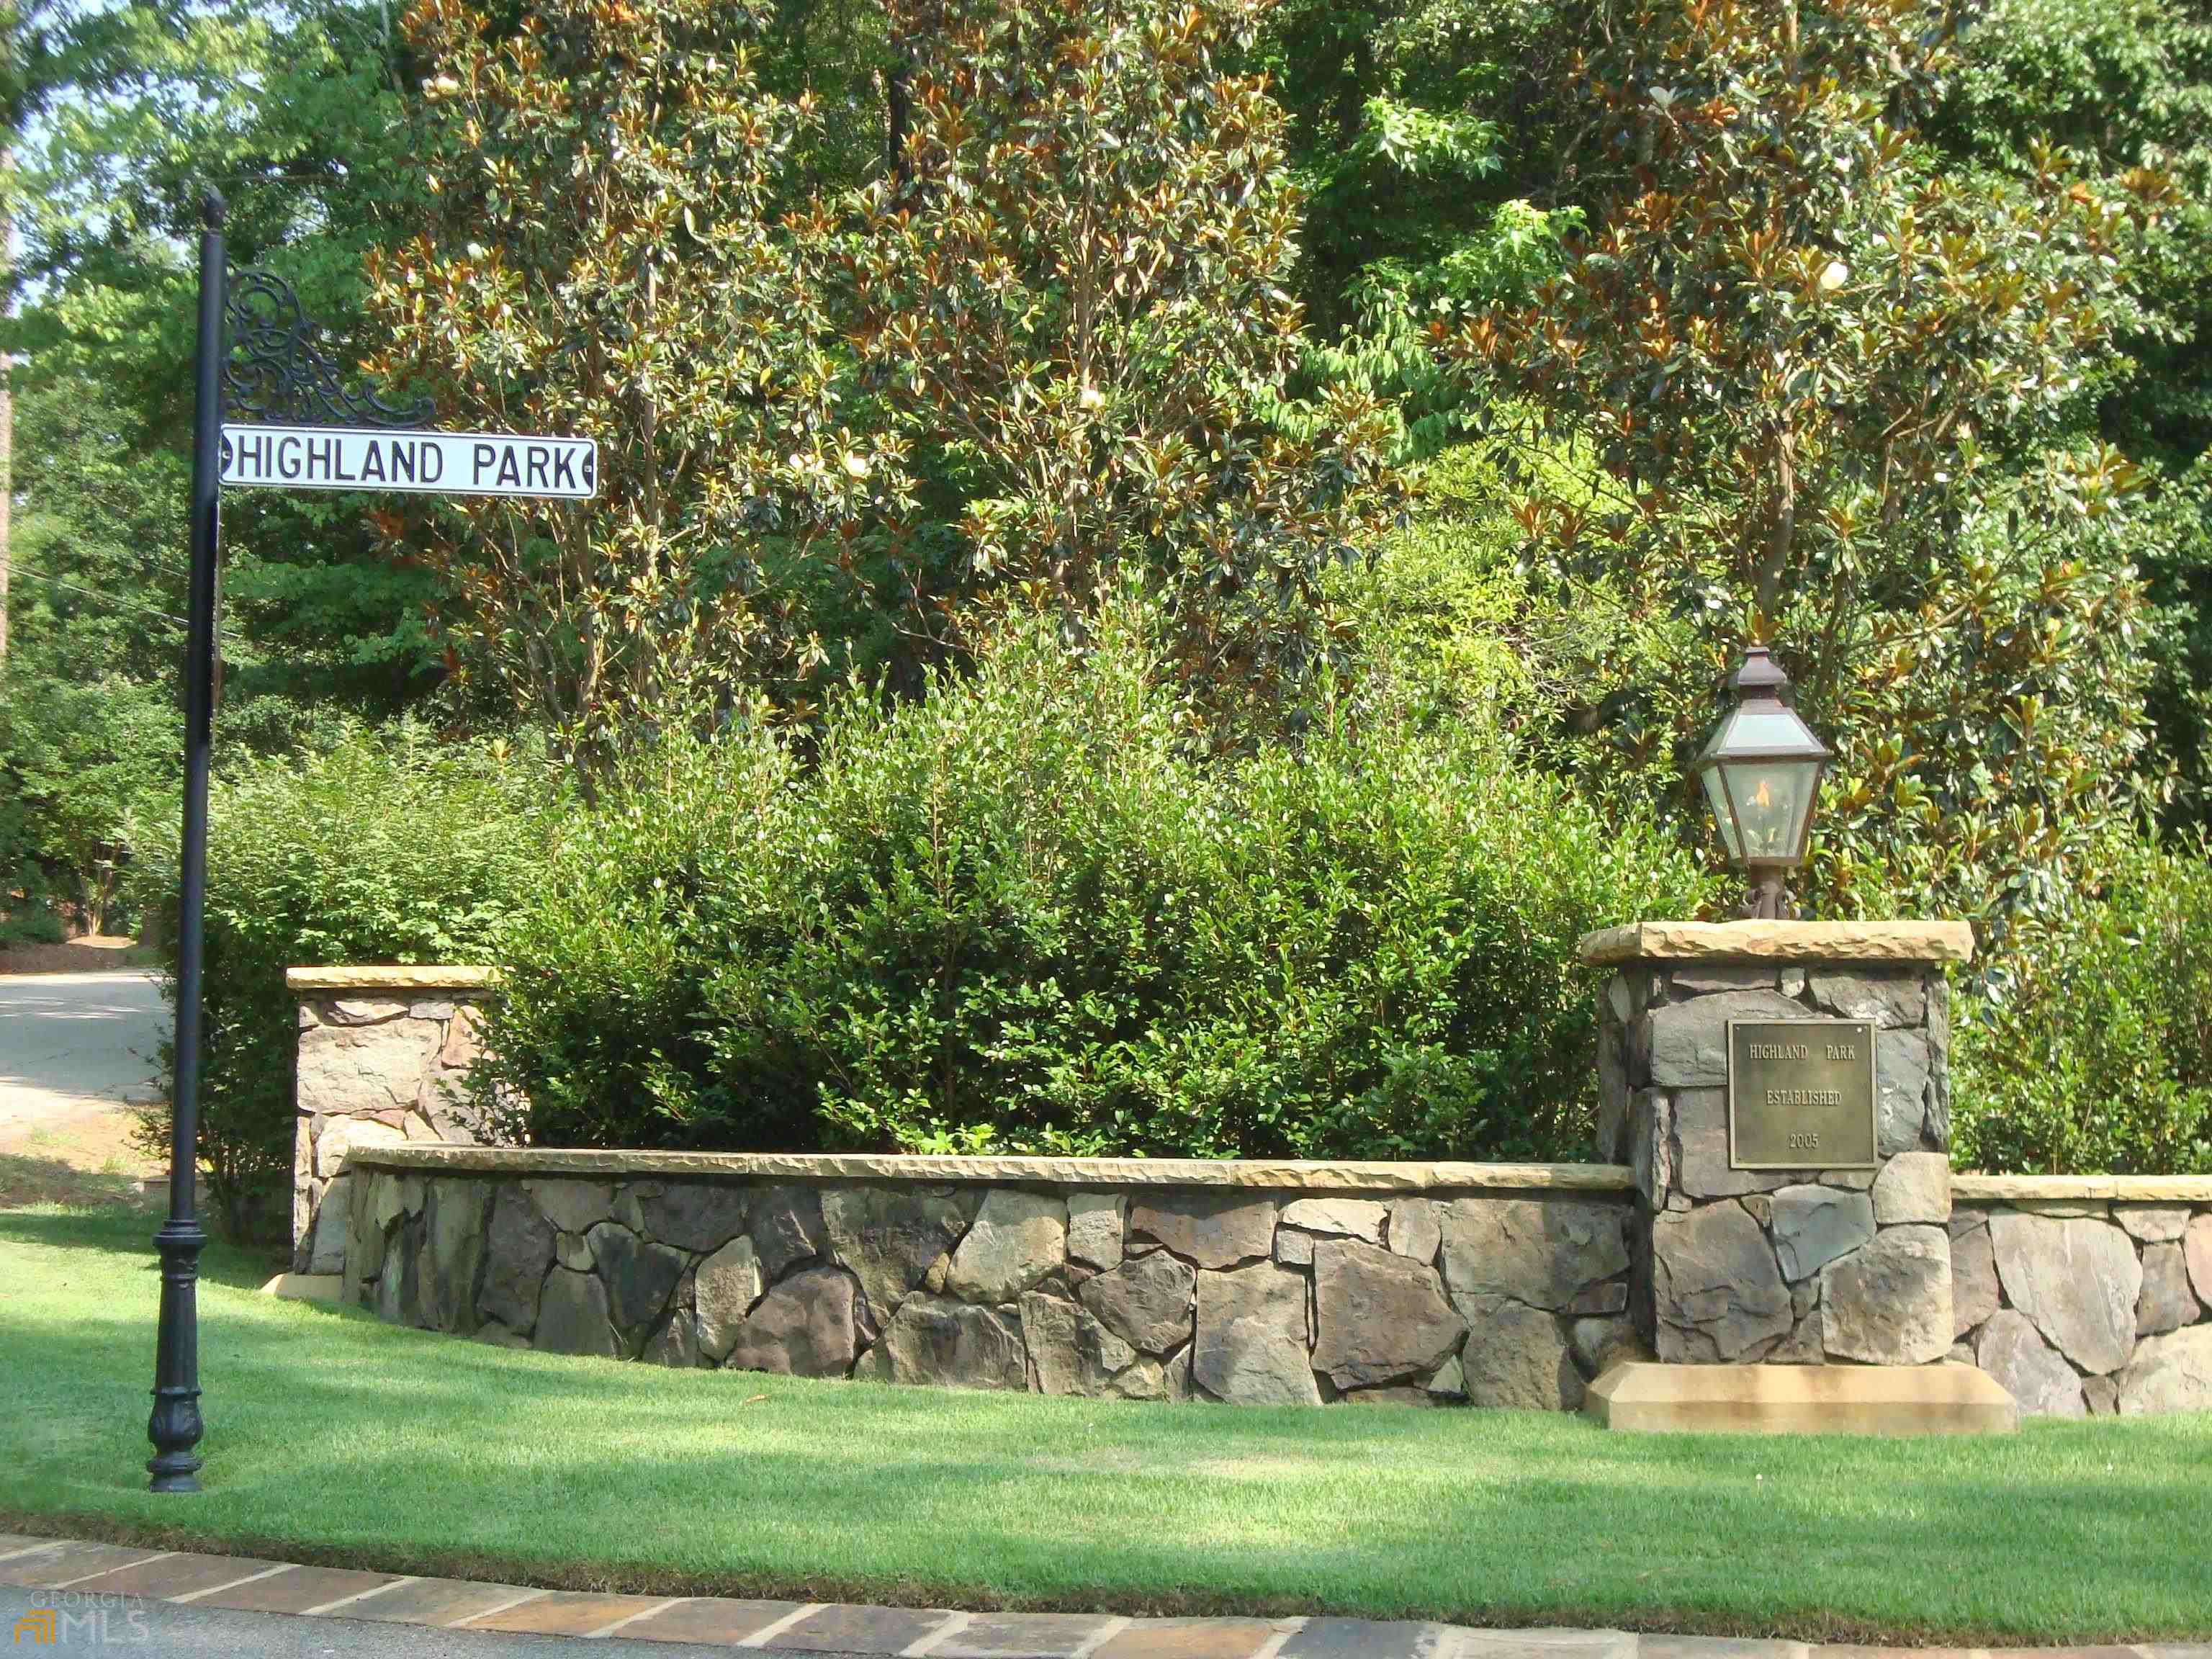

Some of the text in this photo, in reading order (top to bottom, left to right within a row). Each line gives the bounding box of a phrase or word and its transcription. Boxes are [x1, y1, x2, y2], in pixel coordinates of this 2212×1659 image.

[237, 434, 577, 490] HIGHLAND PARK
[1749, 1044, 1856, 1060] HIGHLAND PARK
[1766, 1089, 1842, 1106] ESTABLISHED
[1789, 1133, 1819, 1149] 2005
